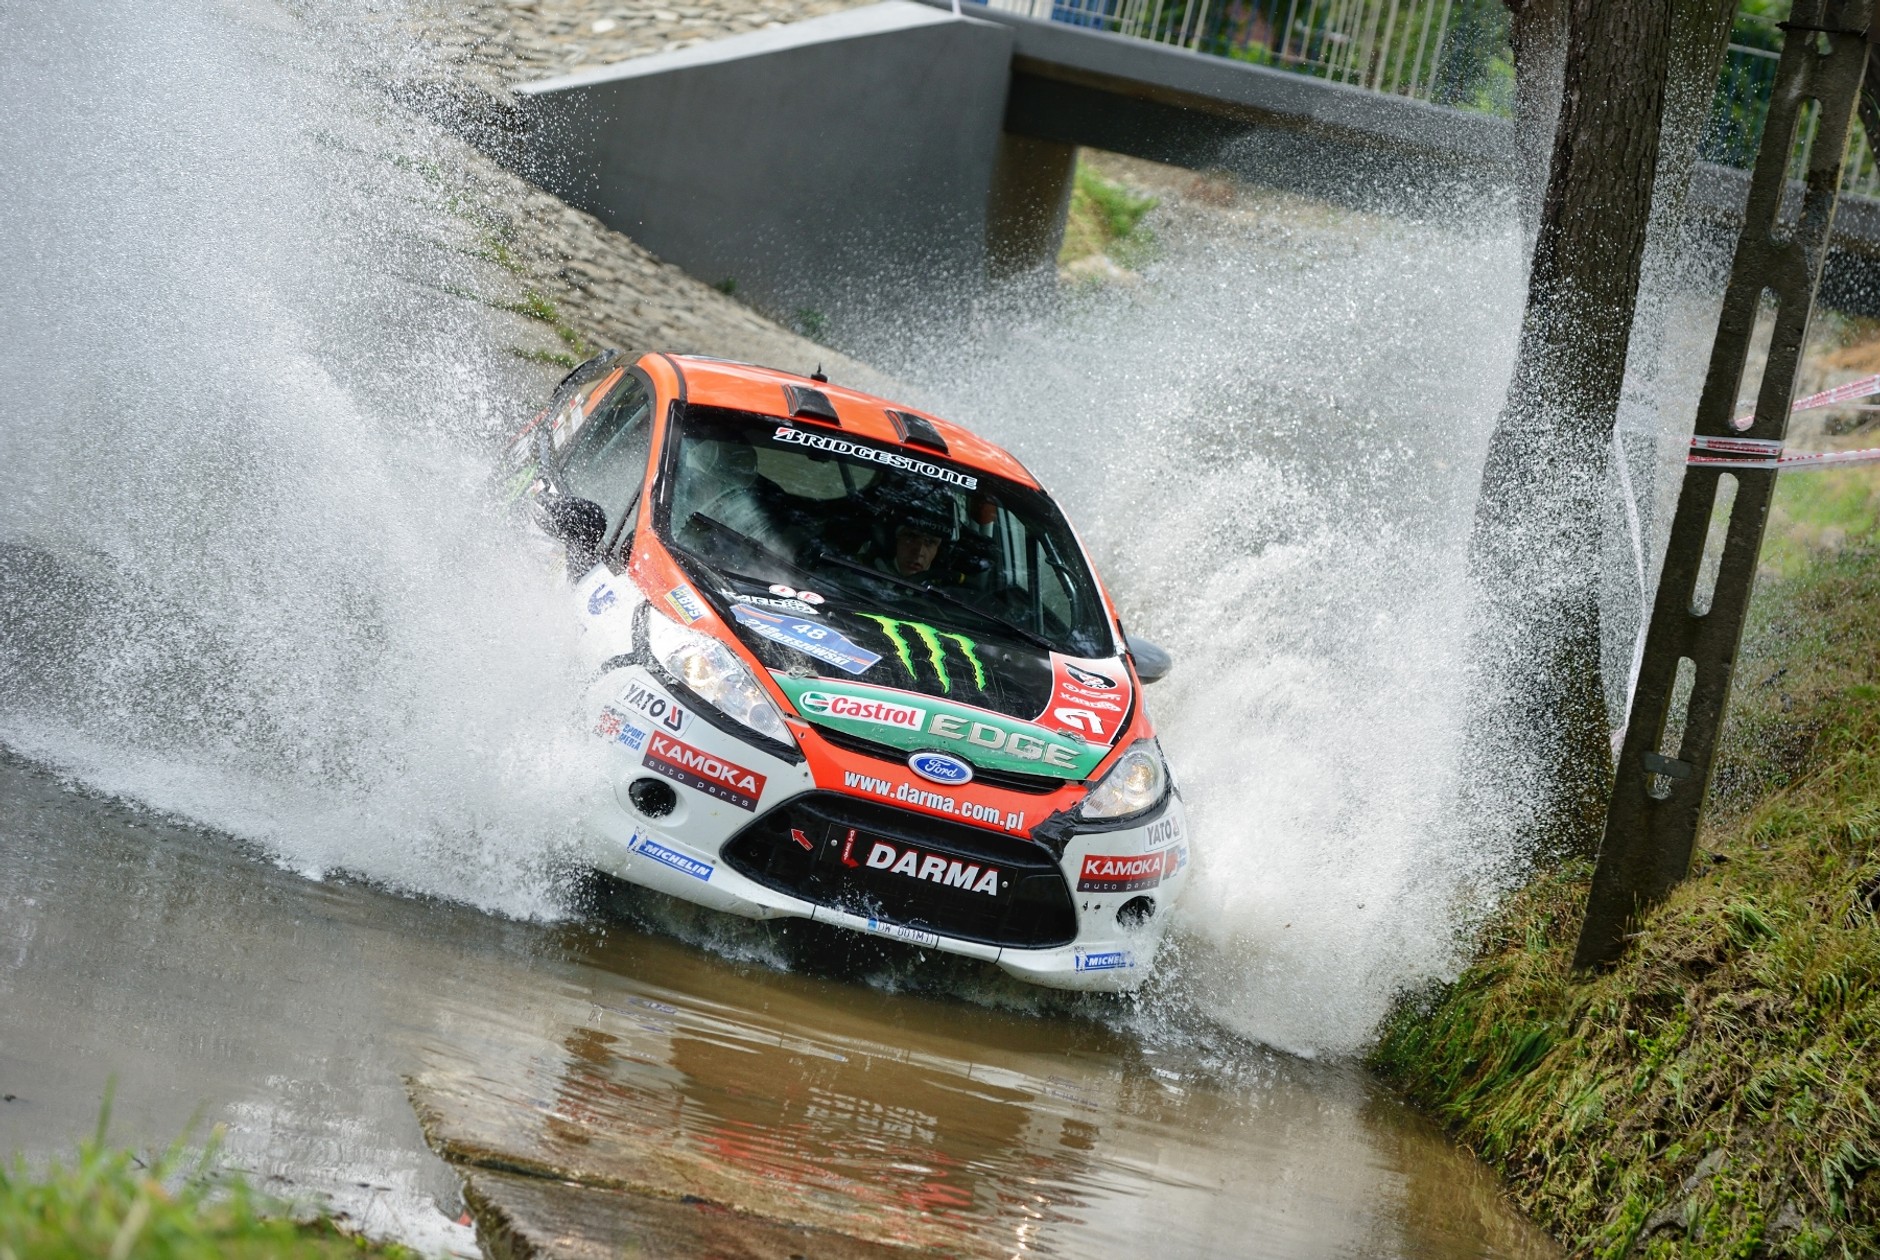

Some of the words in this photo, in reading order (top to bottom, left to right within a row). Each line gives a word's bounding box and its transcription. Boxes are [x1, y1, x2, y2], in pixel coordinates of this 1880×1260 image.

[773, 427, 977, 490] BRIDGESTONE
[791, 624, 828, 640] 48
[623, 683, 666, 717] YATO
[831, 697, 917, 727] Castrol
[927, 713, 1083, 770] EDGE
[651, 736, 757, 794] KAMOKA
[924, 757, 960, 779] Ford
[648, 760, 685, 780] auto
[697, 781, 749, 807] parts
[844, 771, 1025, 830] www.darma.com.pl
[1147, 819, 1172, 845] YATO
[644, 844, 710, 876] MICHELIN
[865, 841, 1000, 897] DARMA
[1085, 857, 1161, 876] KAMOKA
[1083, 882, 1117, 890] auto
